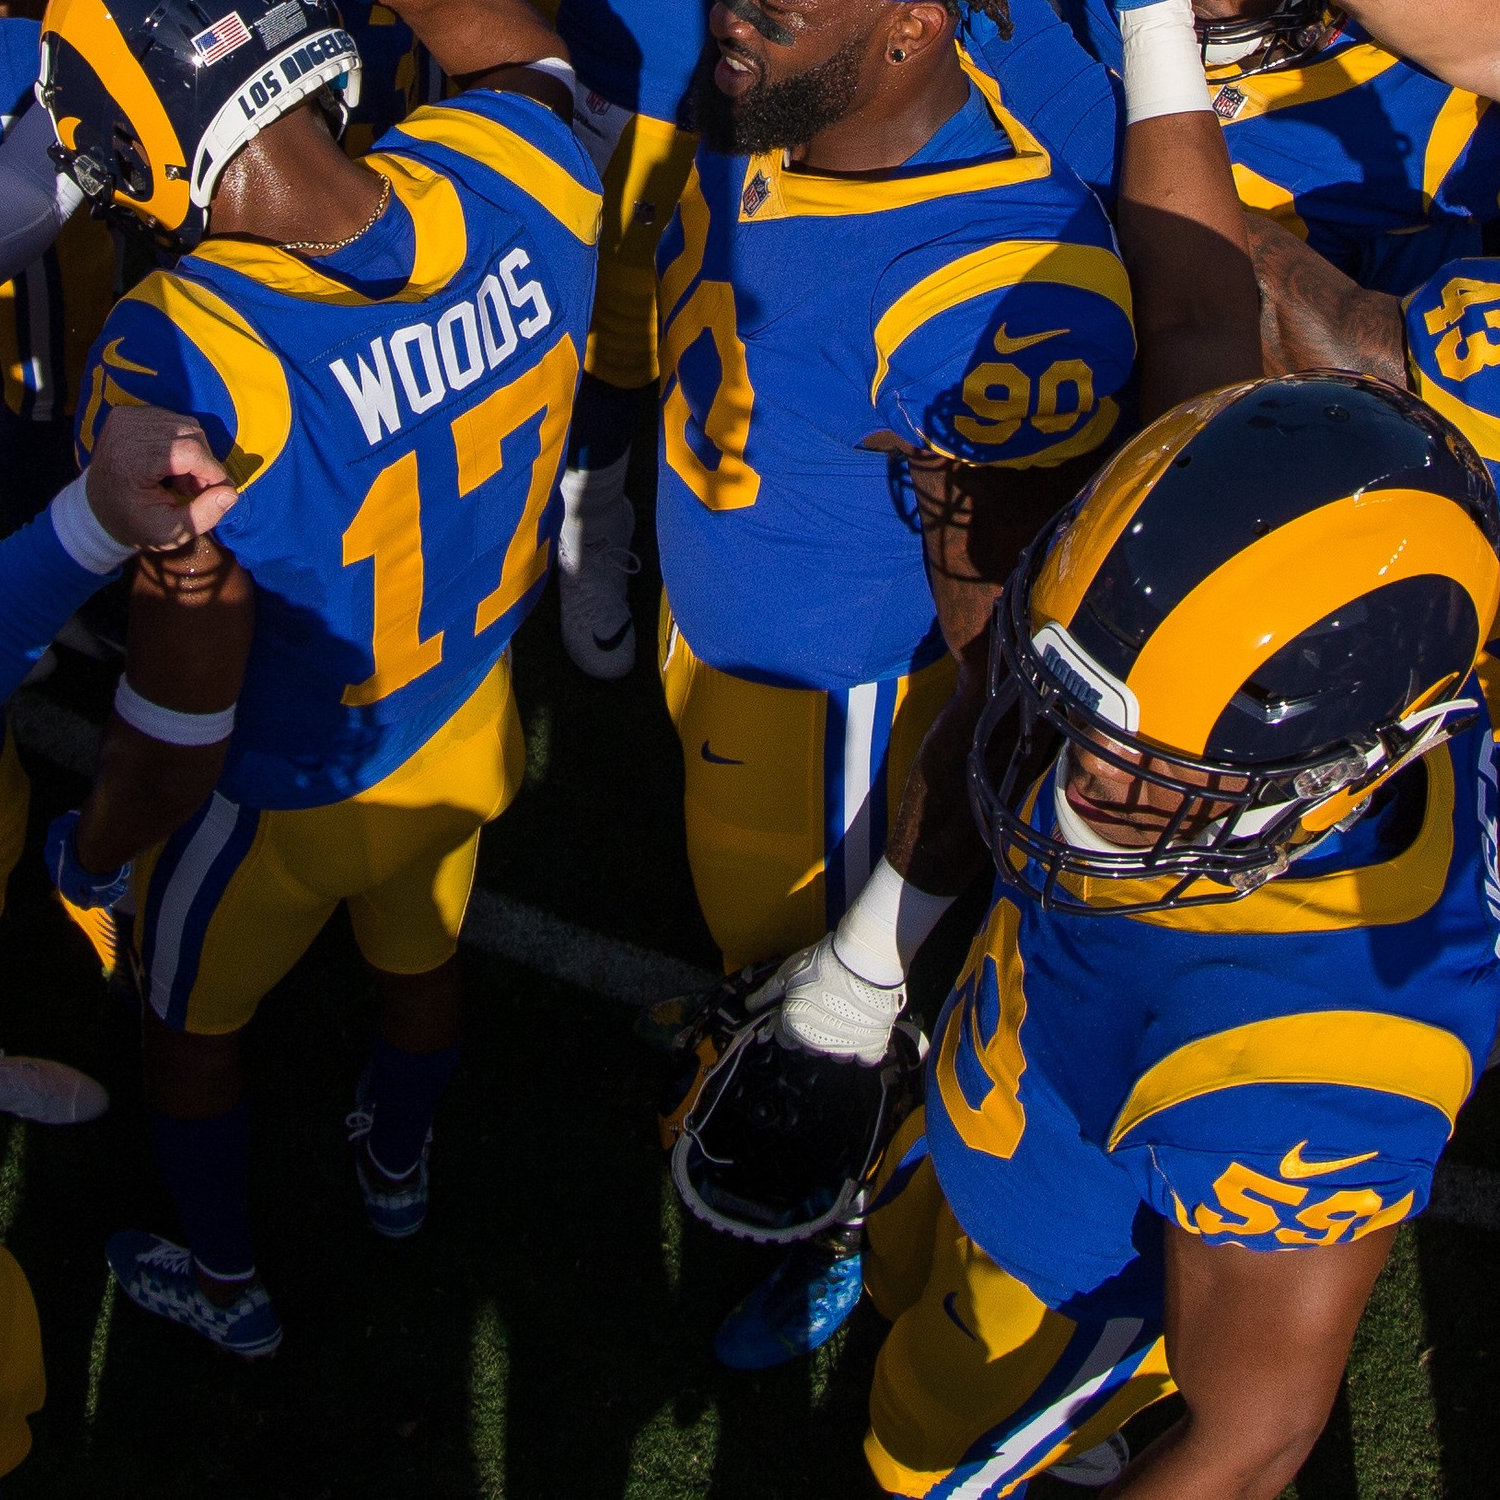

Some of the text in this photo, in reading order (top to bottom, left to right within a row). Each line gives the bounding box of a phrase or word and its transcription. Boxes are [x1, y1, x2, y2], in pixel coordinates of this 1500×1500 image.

[238, 30, 357, 120] LOS ANGELES
[329, 248, 553, 448] WOODS
[954, 359, 1094, 445] 90
[341, 333, 579, 708] 17
[1042, 643, 1105, 714] RAMS
[1195, 1160, 1382, 1248] 59
